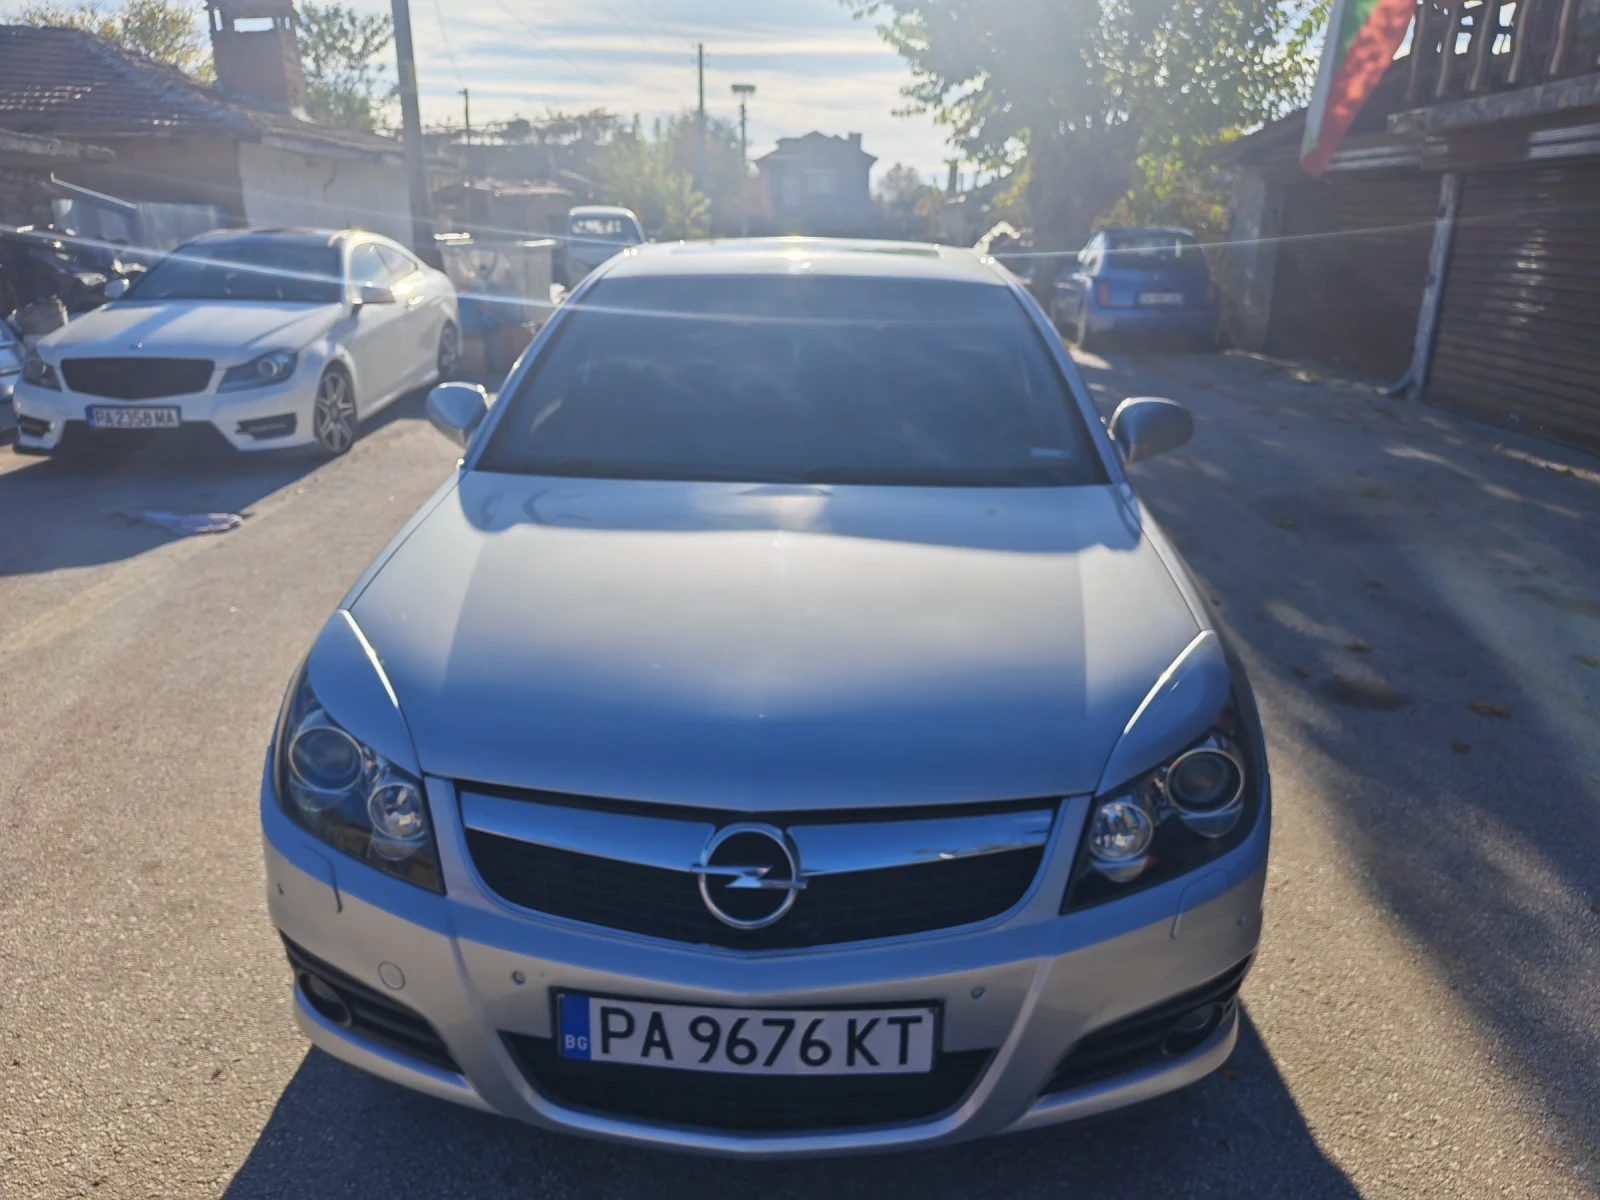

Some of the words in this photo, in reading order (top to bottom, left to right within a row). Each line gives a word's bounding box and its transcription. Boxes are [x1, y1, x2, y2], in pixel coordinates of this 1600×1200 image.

[95, 410, 113, 425] PA
[565, 1035, 588, 1051] BG
[600, 1006, 674, 1061] PA
[688, 1015, 832, 1067] 9676
[846, 1016, 923, 1067] KT
